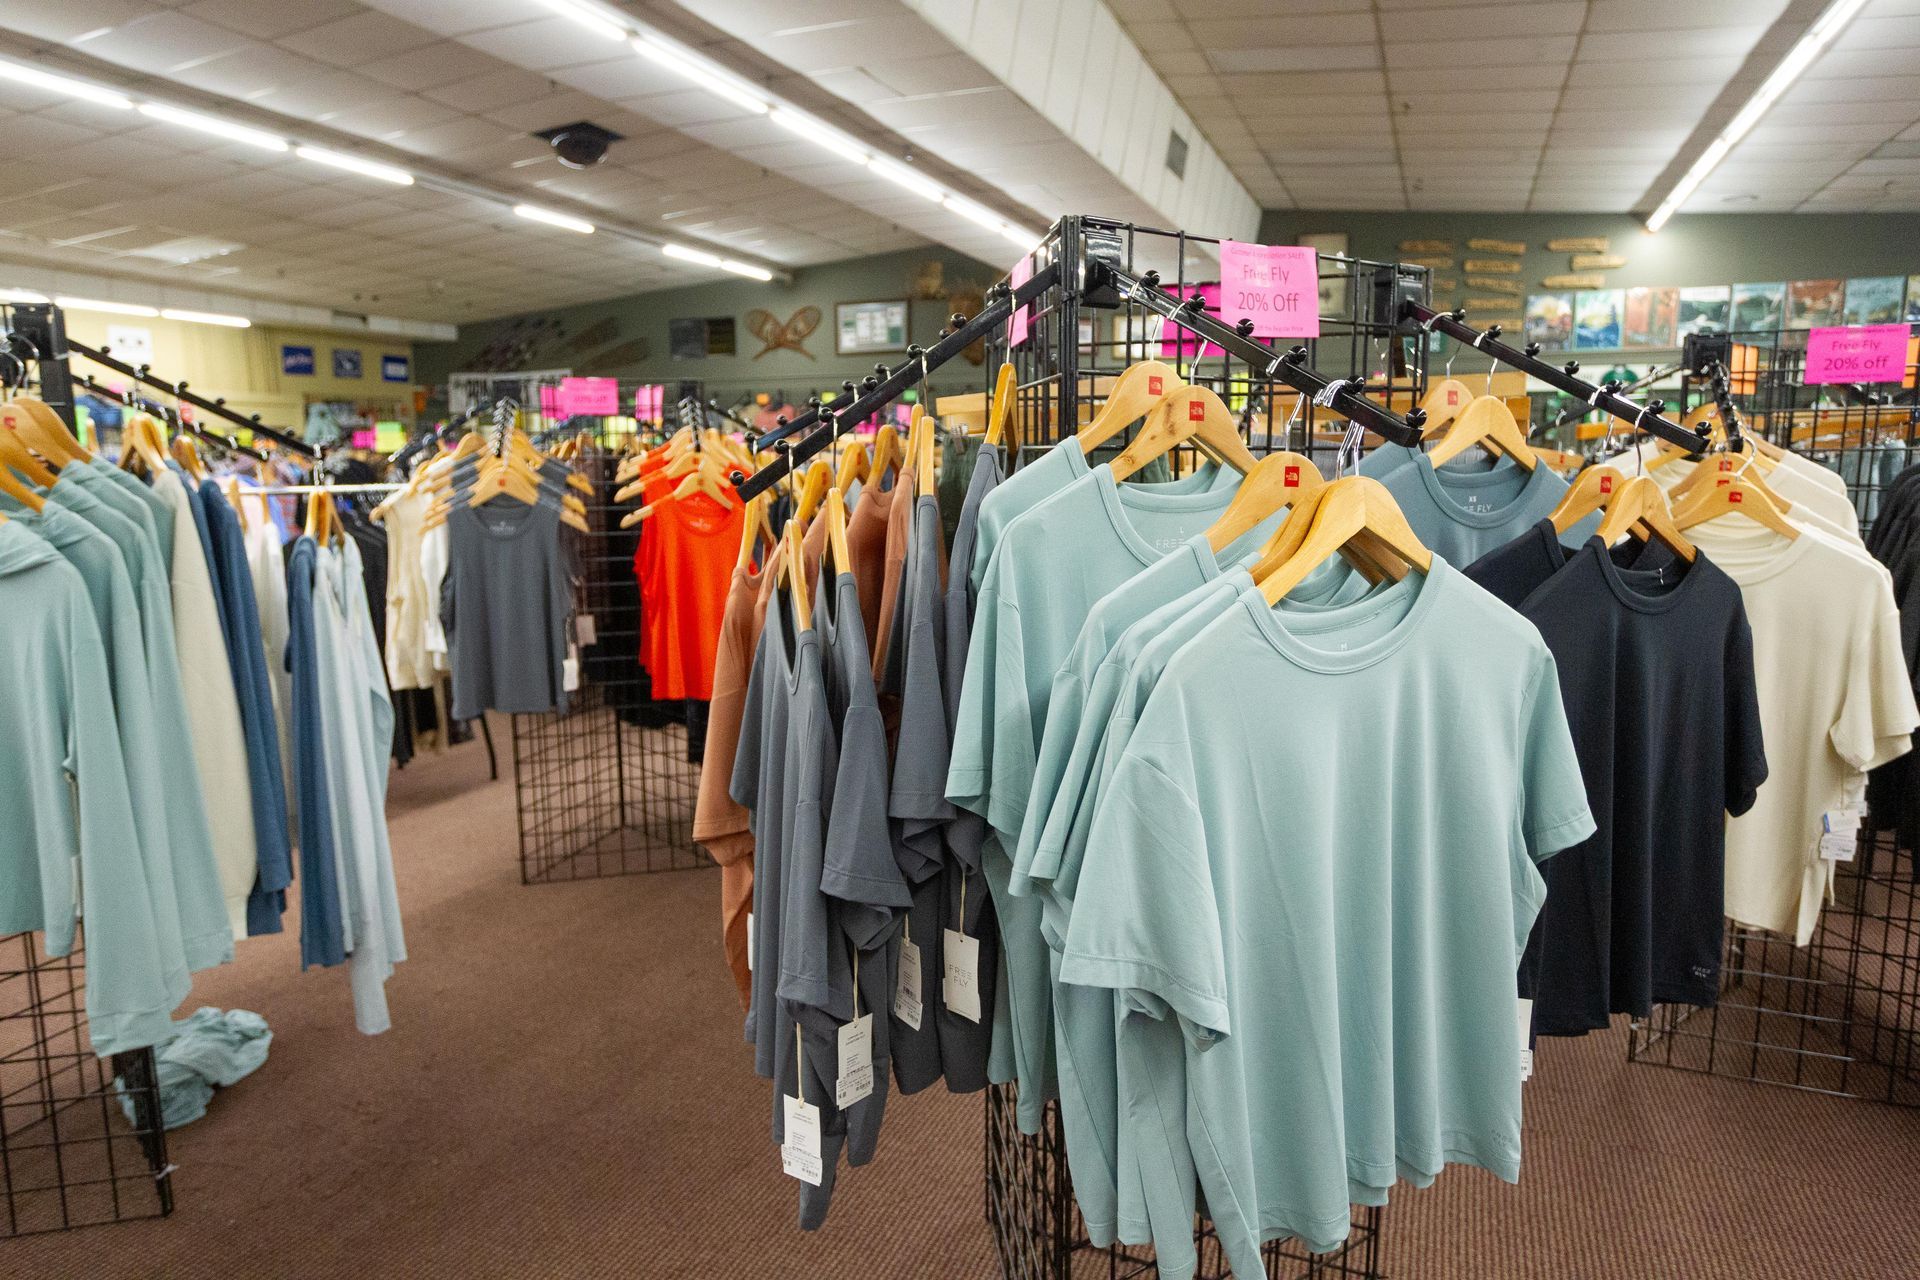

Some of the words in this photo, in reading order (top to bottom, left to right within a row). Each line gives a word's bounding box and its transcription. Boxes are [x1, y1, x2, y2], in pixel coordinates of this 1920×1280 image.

[1243, 264, 1268, 281] Free
[1271, 266, 1290, 285] Fly
[1238, 291, 1268, 312] 20%
[1273, 293, 1300, 312] Off
[1832, 340, 1858, 351] Free
[1863, 339, 1881, 351] Fly
[1823, 357, 1858, 371] 20%
[1864, 356, 1888, 370] off
[1477, 504, 1493, 513] FLY
[1156, 538, 1186, 550] FREE
[949, 963, 973, 980] FREE
[953, 975, 969, 988] FLY
